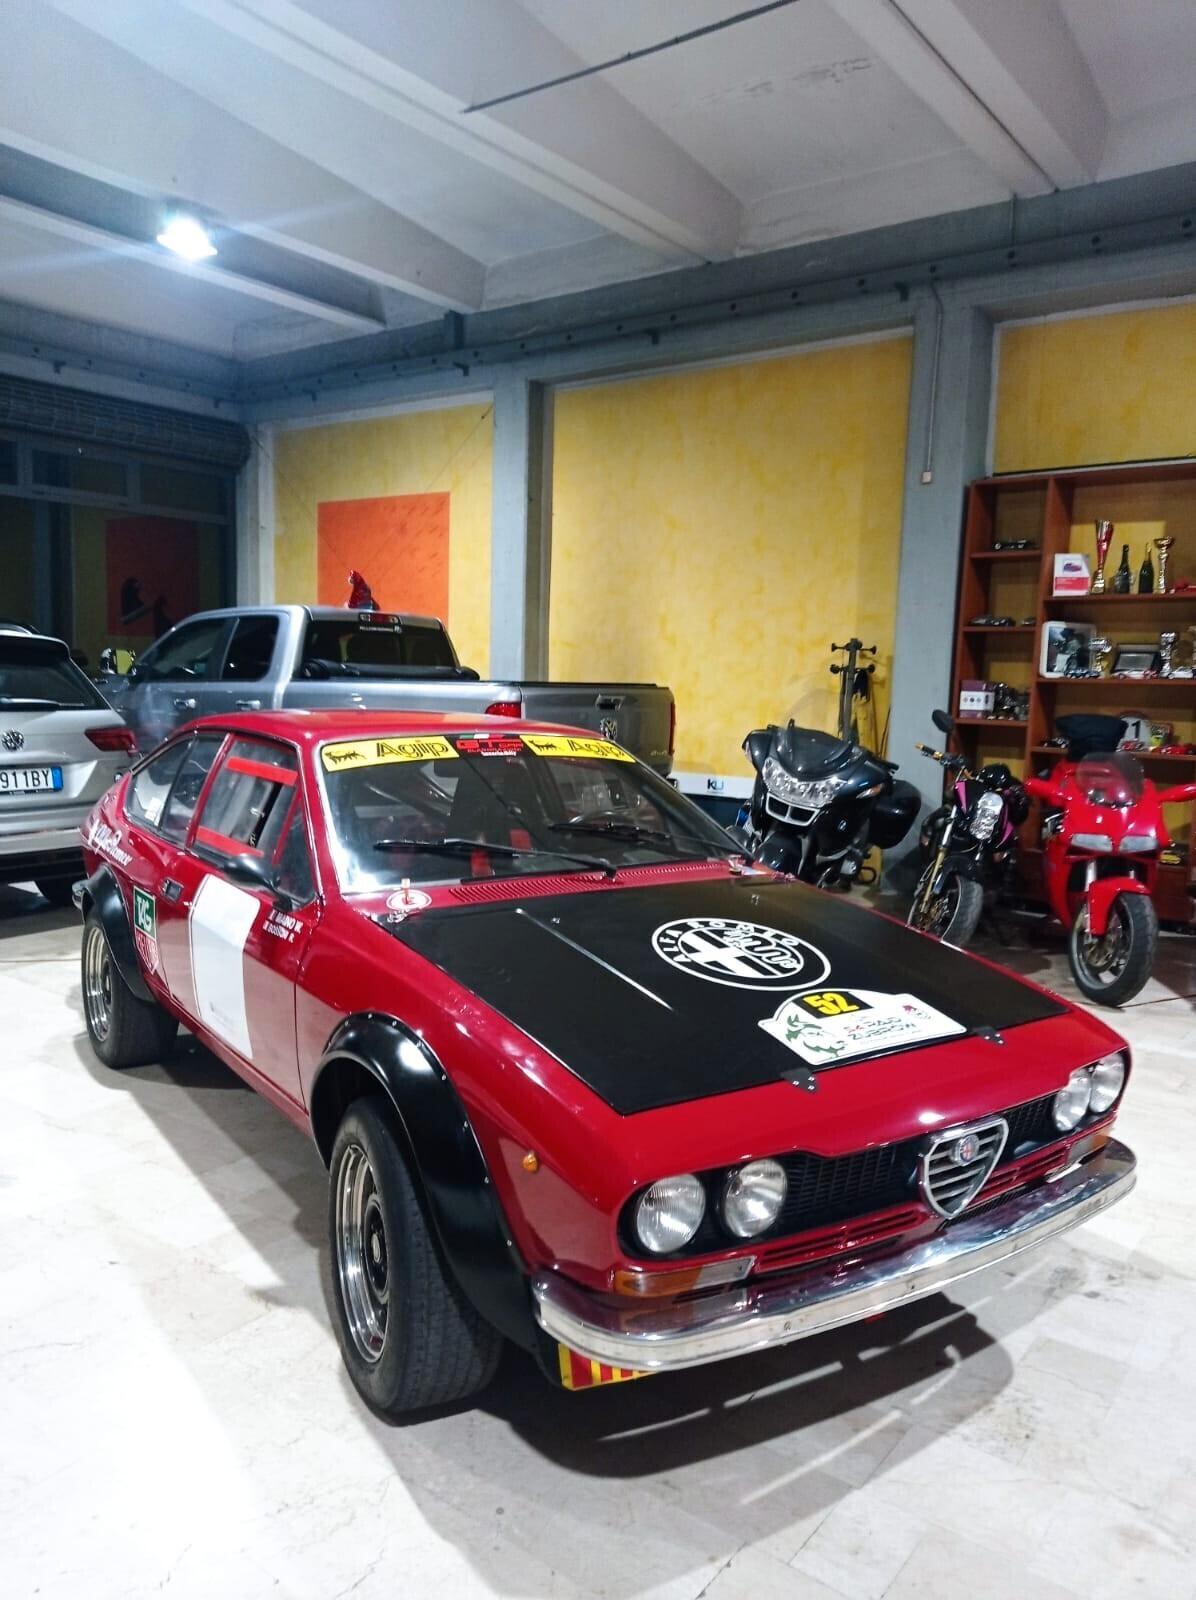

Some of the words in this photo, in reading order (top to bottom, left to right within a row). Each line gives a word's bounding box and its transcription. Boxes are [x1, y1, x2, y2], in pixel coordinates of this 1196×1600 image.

[376, 739, 450, 760] Agip
[569, 739, 626, 758] Agip
[0, 768, 50, 790] 911BY
[659, 929, 691, 963] ALFA
[803, 992, 860, 1015] 52
